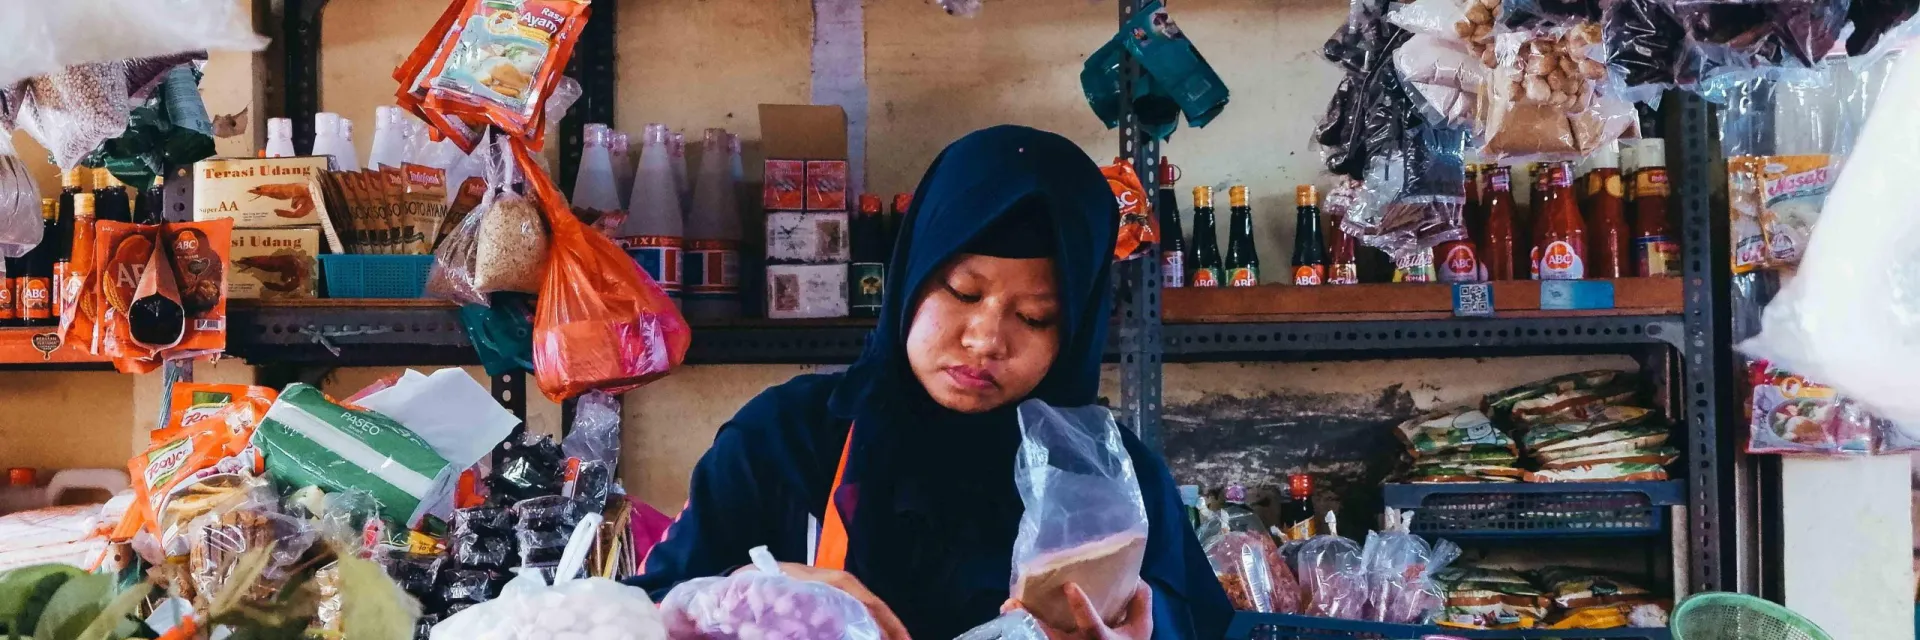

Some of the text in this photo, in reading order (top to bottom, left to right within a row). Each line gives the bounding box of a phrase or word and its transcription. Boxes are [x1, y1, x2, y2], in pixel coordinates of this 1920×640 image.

[541, 7, 566, 24] Rasa
[520, 12, 559, 34] Ayam
[203, 165, 311, 180] Terasi Udang
[218, 200, 239, 213] AA
[405, 202, 448, 217] SOTO AYAM
[175, 240, 197, 250] ABC
[250, 235, 302, 249] Udang
[1451, 258, 1472, 268] ABC
[1548, 254, 1571, 265] ABC
[1295, 275, 1317, 286] ABC
[25, 289, 46, 299] ABC
[340, 411, 381, 436] PASEO
